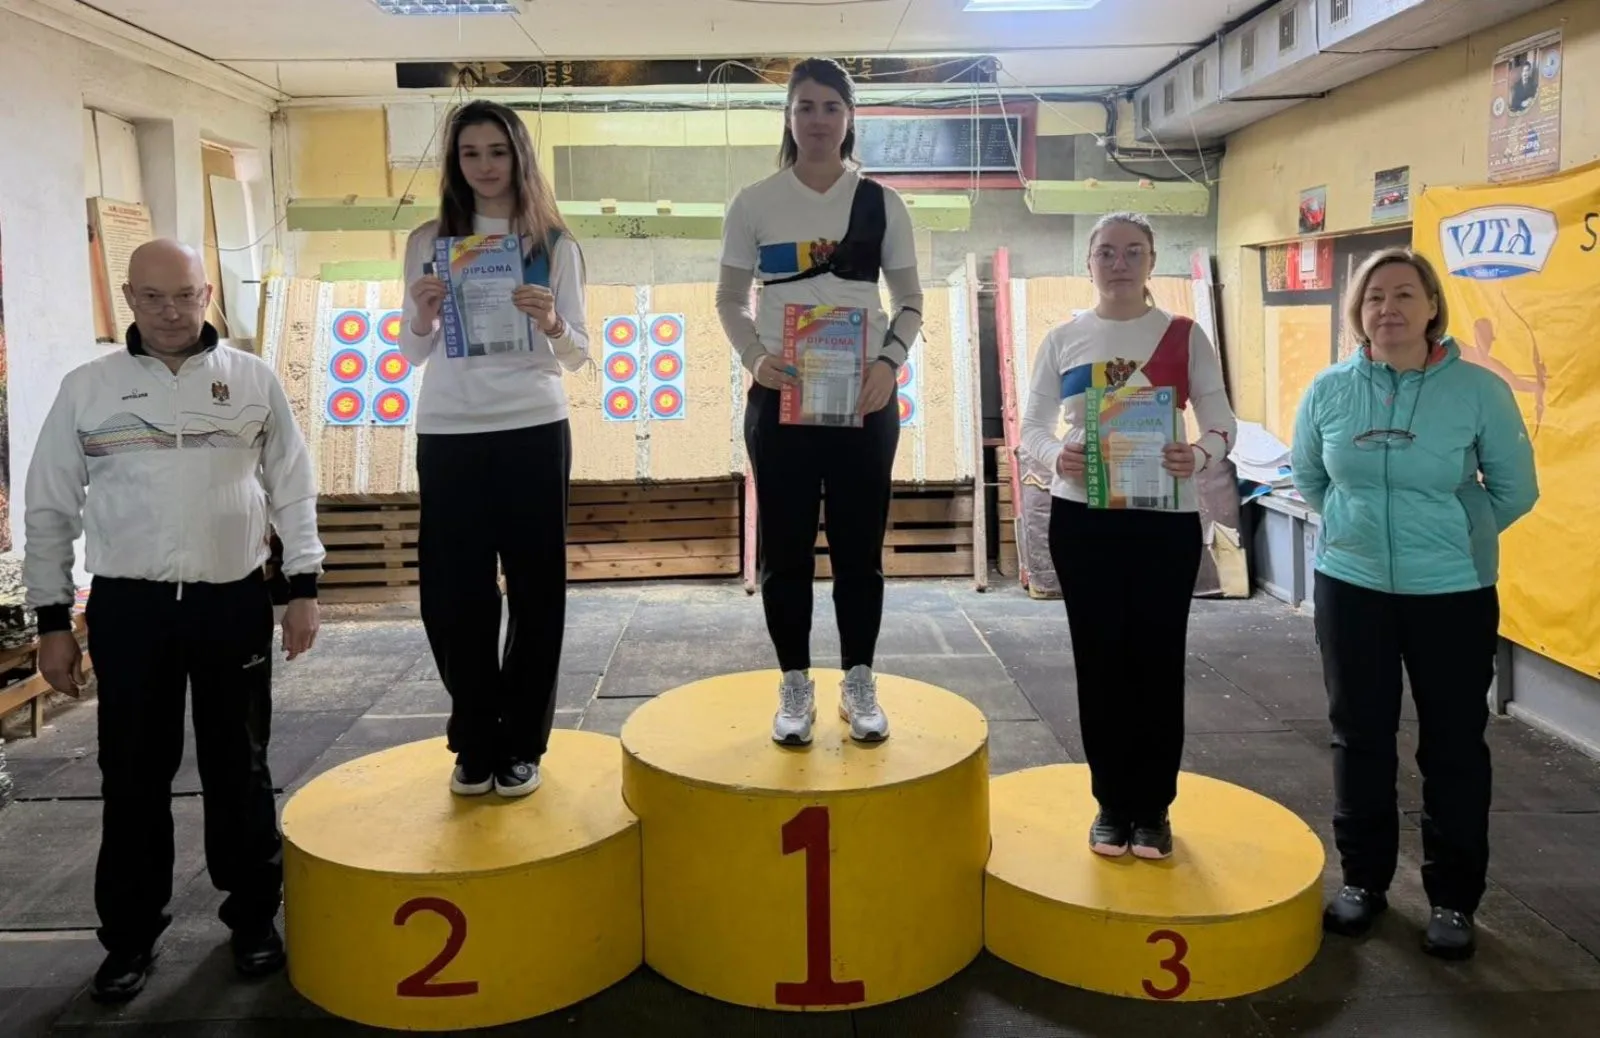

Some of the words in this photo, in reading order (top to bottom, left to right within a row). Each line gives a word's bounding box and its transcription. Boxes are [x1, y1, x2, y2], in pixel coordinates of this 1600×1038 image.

[1447, 218, 1536, 258] VITA
[462, 264, 512, 275] DIPLOMA
[806, 336, 855, 346] DIPLOMA
[1110, 417, 1163, 427] DIPLOMA
[775, 806, 865, 1005] 1
[393, 896, 479, 998] 2
[1141, 929, 1191, 1000] 3
